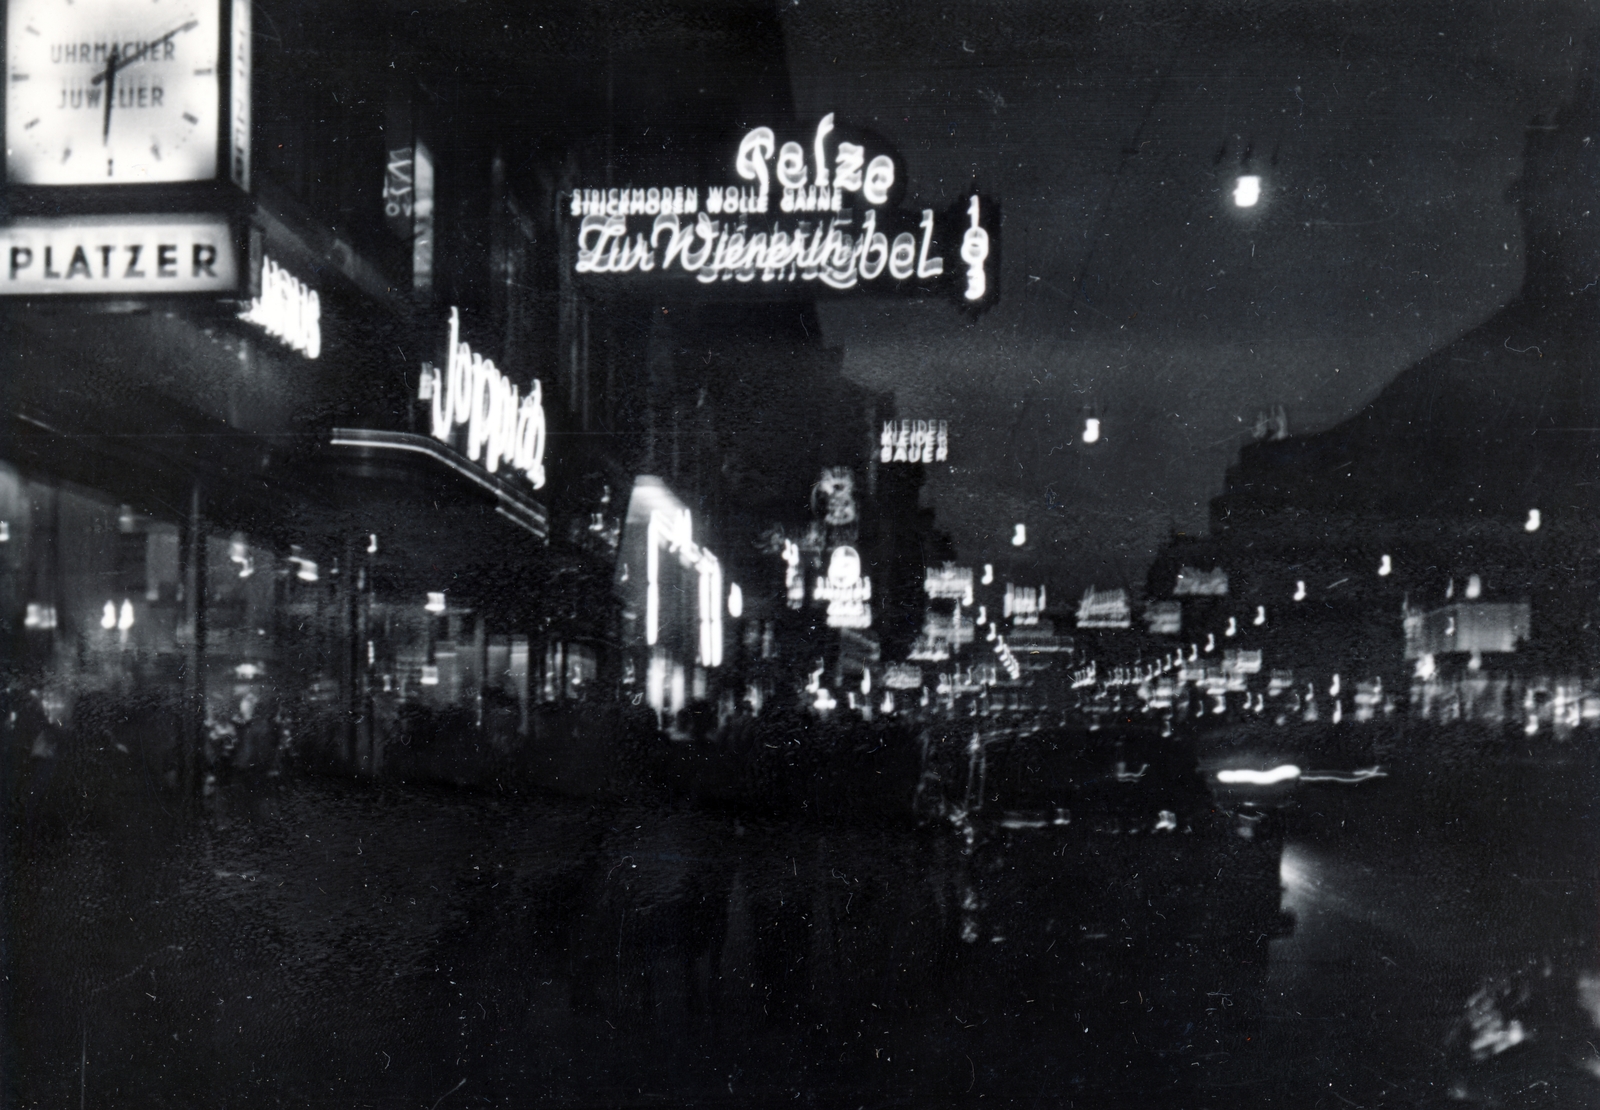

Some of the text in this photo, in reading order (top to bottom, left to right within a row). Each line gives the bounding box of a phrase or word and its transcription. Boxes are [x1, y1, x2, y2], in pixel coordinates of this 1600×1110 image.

[51, 41, 175, 64] UHRMACHER
[57, 86, 164, 109] JUWLIER
[736, 113, 895, 206] Pelze
[570, 186, 843, 215] STRICKMODEN WOLLE GARNE
[576, 214, 655, 273] Zur
[9, 243, 218, 281] PLATZER
[881, 419, 949, 446] KLEIDER
[881, 443, 948, 464] BAUER
